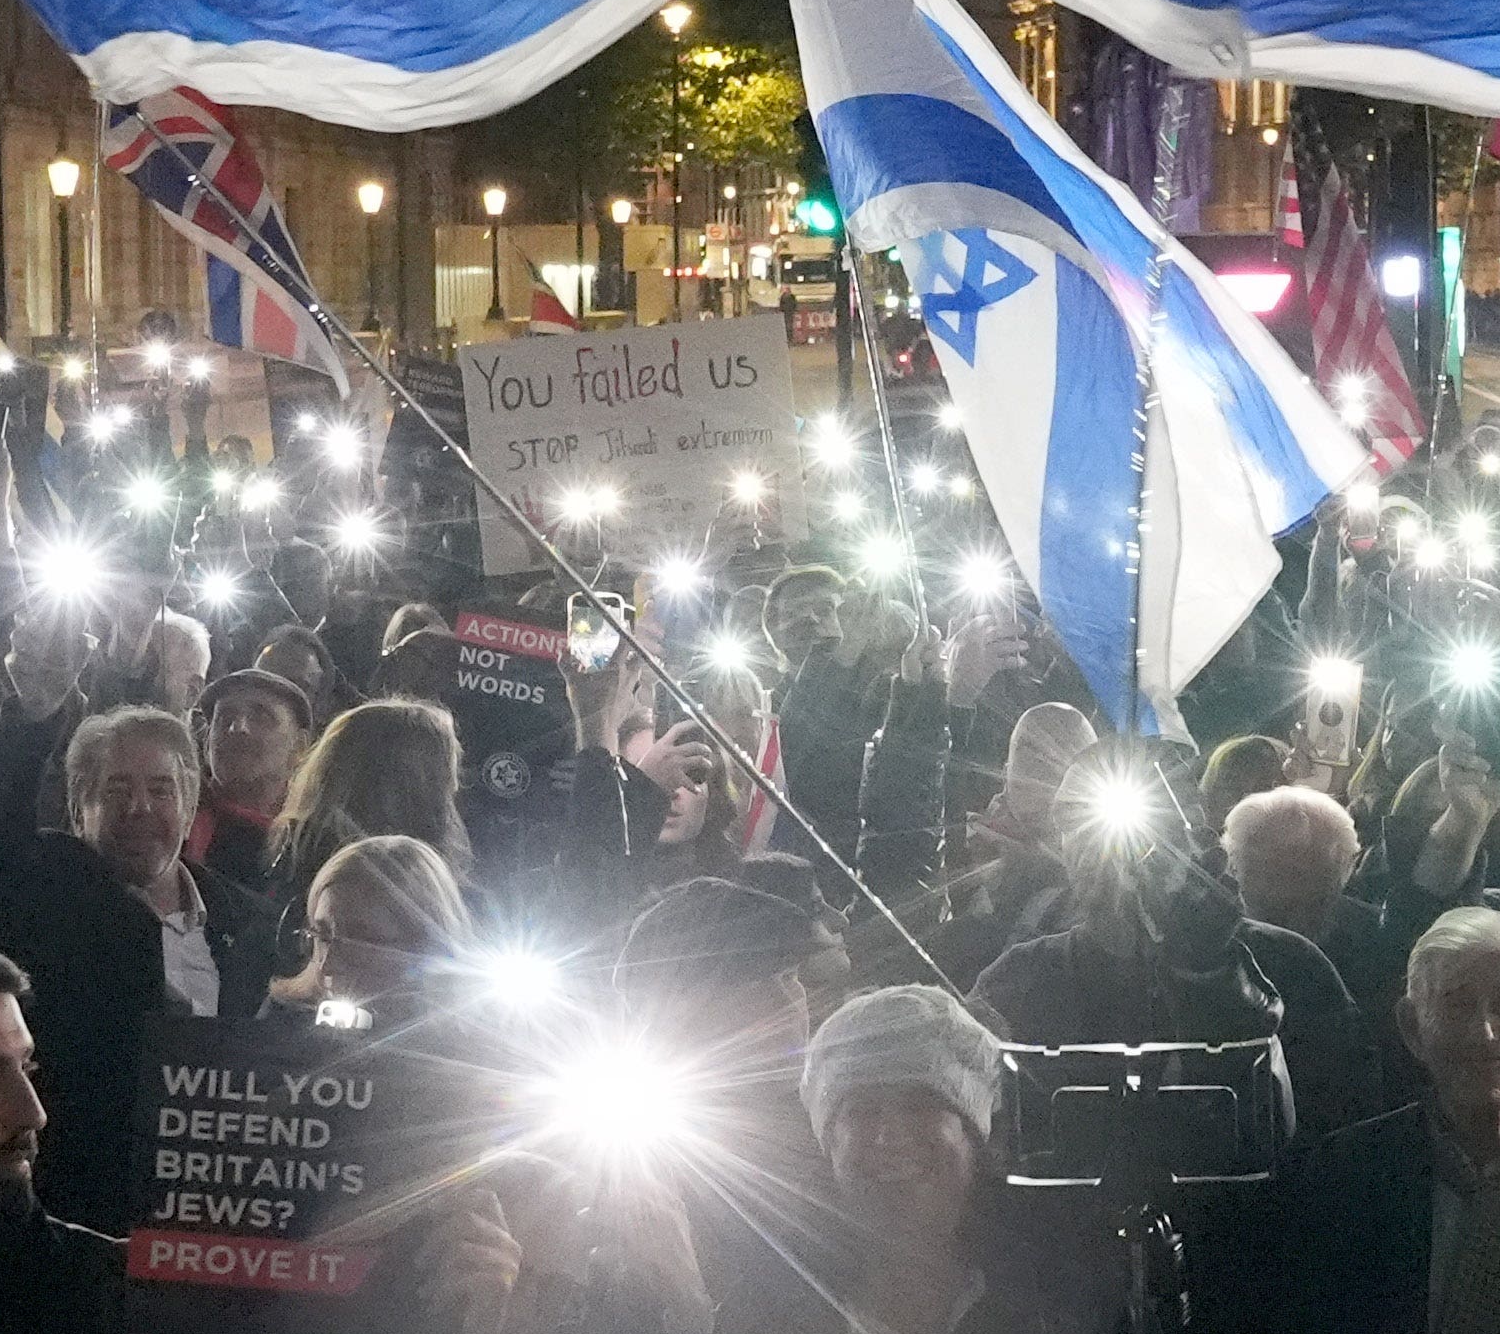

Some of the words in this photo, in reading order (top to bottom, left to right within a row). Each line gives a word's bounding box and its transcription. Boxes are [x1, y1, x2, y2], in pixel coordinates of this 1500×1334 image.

[472, 356, 554, 413] You
[573, 338, 684, 406] failed
[708, 354, 758, 389] us
[508, 434, 580, 471] STOP
[459, 645, 510, 671] NOT
[458, 670, 545, 704] WORDS
[162, 1066, 268, 1103] WILL
[283, 1074, 373, 1110] YOU
[158, 1108, 331, 1149] DEFEND
[156, 1149, 365, 1194] BRITAIN'S
[154, 1191, 295, 1230] JEWS?
[149, 1240, 293, 1279] PROVE
[307, 1251, 346, 1284] IT
